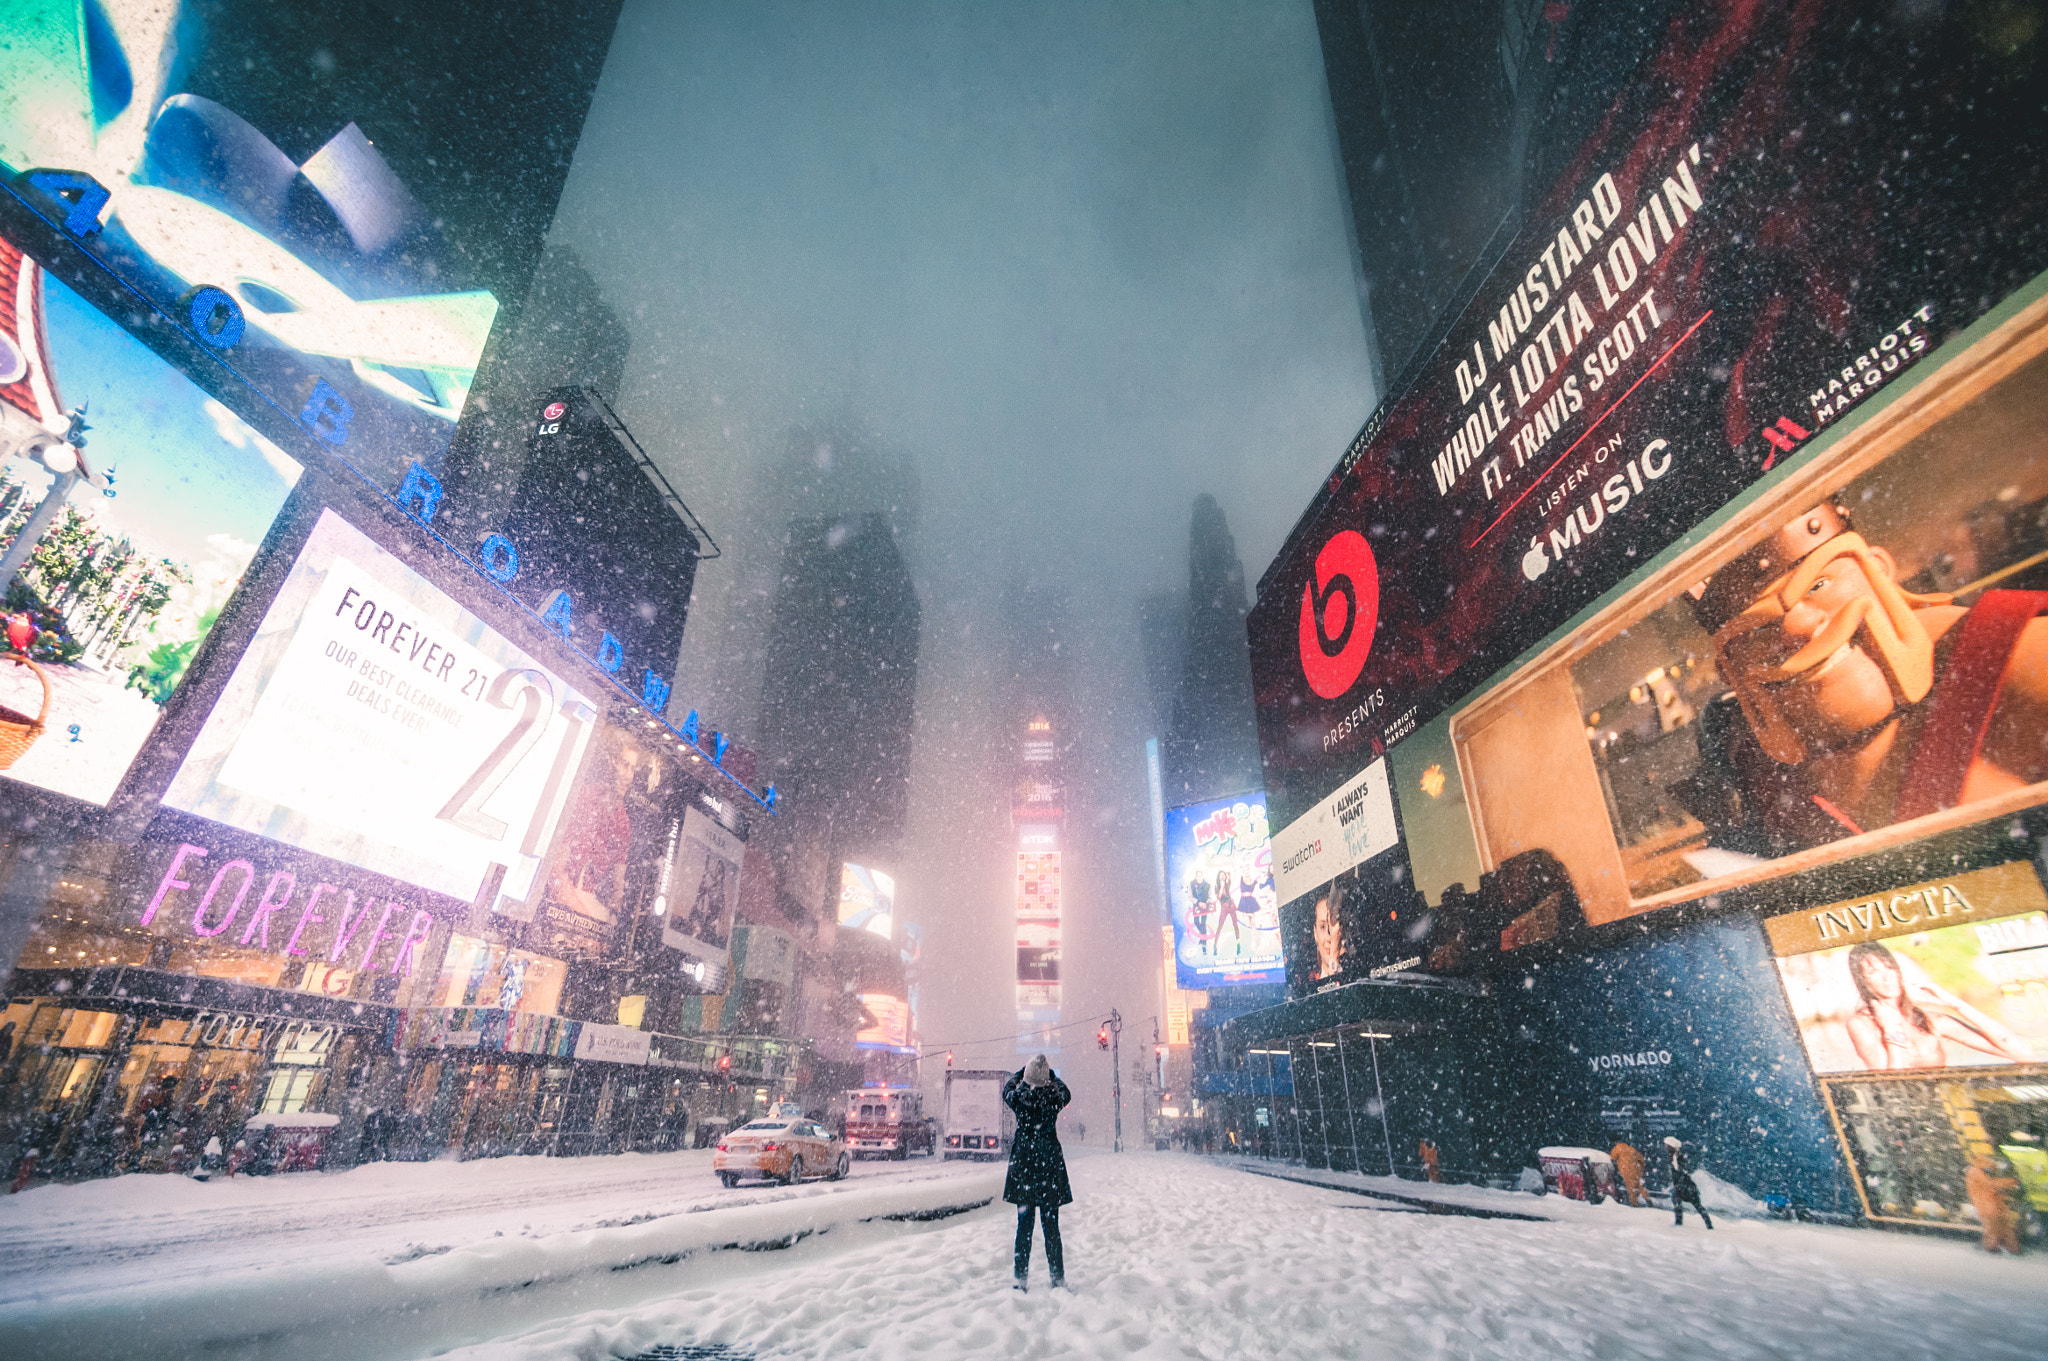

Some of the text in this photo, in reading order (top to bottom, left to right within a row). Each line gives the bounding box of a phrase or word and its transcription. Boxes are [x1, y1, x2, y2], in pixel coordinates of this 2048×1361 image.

[1455, 172, 1622, 405] DJ MUSTARD
[1431, 142, 1704, 496] WHOLE LOTTA LOVIN'
[1809, 305, 1930, 407] MARRIOTT
[1817, 335, 1927, 422] MARQUIS
[1481, 288, 1661, 500] FT. TRAVIS SCOTT
[539, 423, 559, 435] LG
[1344, 404, 1384, 467] MARRIOTT
[1538, 432, 1623, 517] LISTEN ON
[1548, 438, 1672, 560] MUSIC
[300, 376, 728, 763] BROADWAY
[335, 587, 489, 702] FOREVER 21
[324, 640, 358, 669] OUR
[359, 659, 396, 689] BEST
[398, 680, 465, 730] CLEARANCE
[346, 680, 390, 714] DEALS
[393, 706, 431, 735] EVER!
[1323, 688, 1384, 752] PRESENTS
[1384, 705, 1418, 737] MARRIOTT
[1386, 719, 1416, 746] MARQUIS
[1028, 793, 1053, 801] 2016
[1331, 782, 1368, 817] I ALWAYS
[1339, 801, 1364, 827] WANT
[1282, 843, 1316, 874] swatch
[1348, 833, 1369, 857] love
[140, 842, 433, 977] FOREVER
[546, 905, 566, 920] LIVE
[1811, 884, 1974, 940] INVICTA
[184, 1012, 344, 1054] FOREVER 21
[1588, 1050, 1671, 1070] VORNADO
